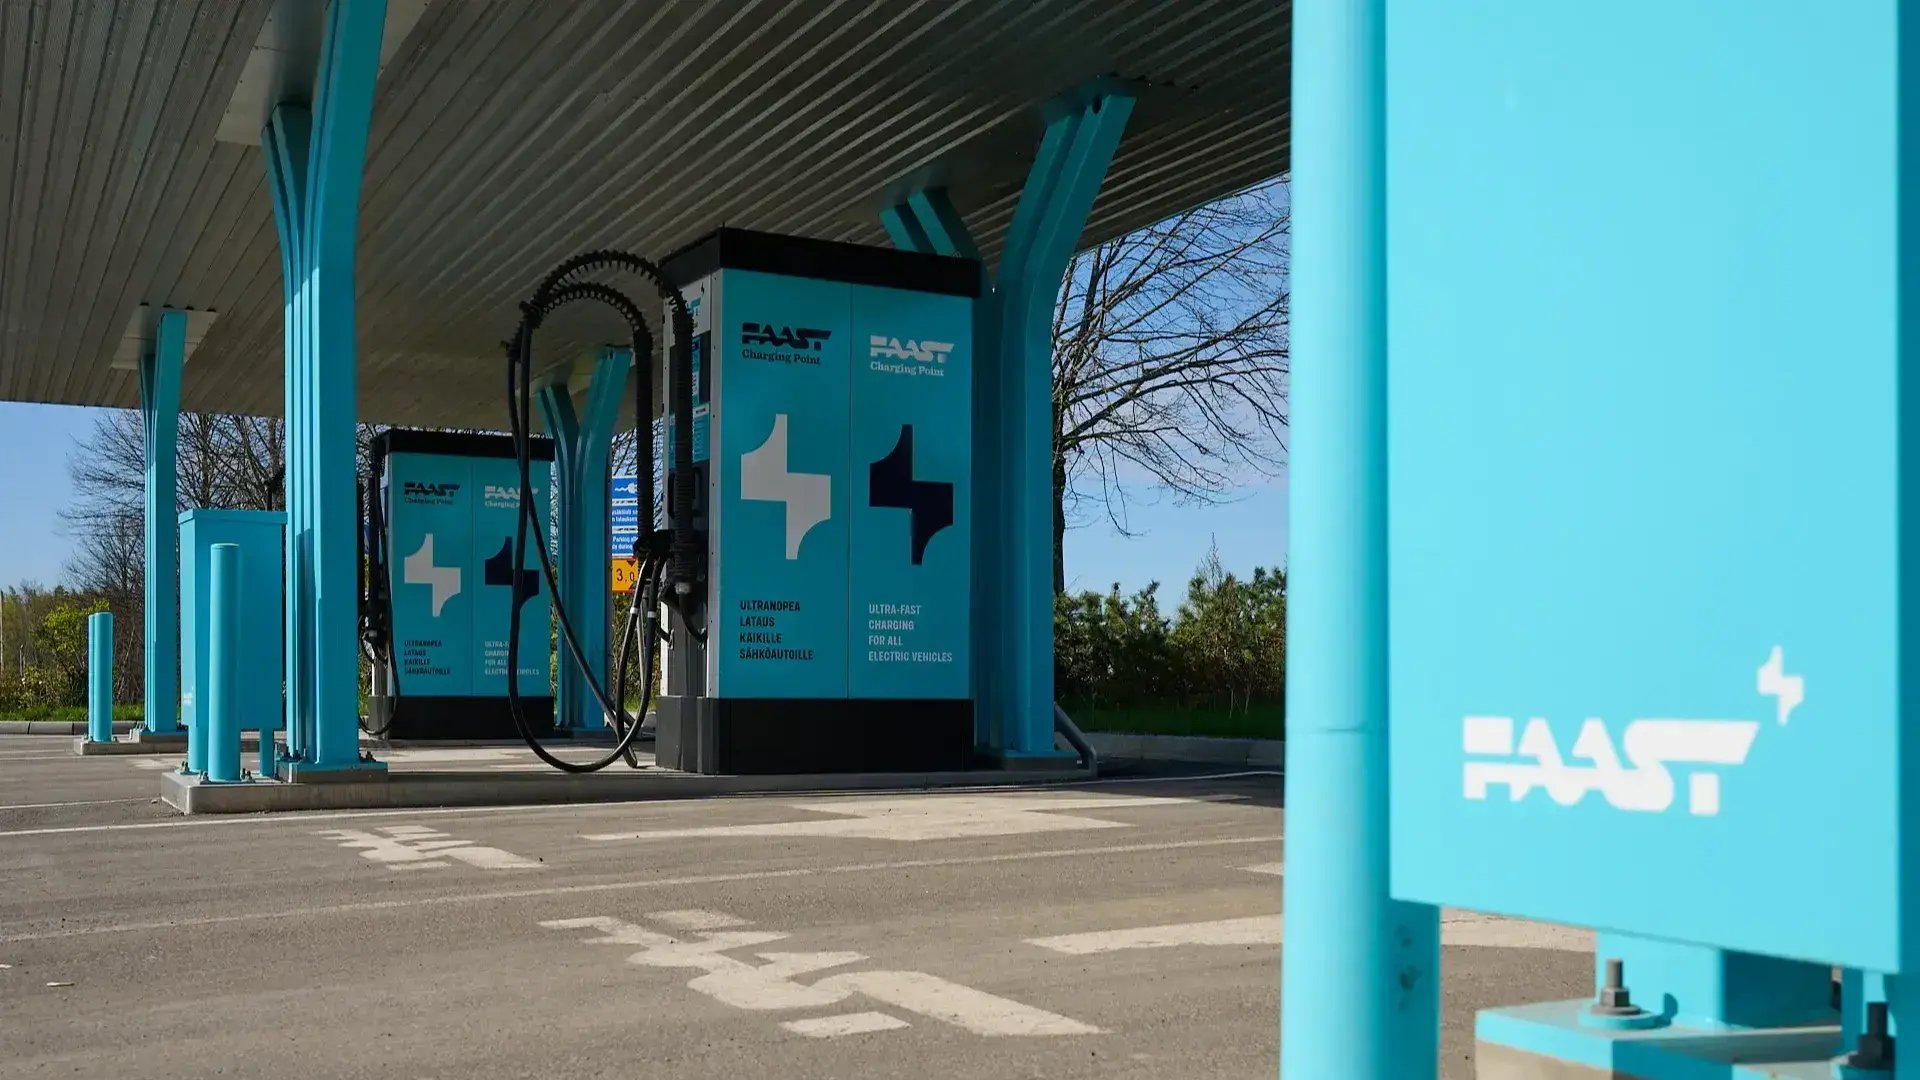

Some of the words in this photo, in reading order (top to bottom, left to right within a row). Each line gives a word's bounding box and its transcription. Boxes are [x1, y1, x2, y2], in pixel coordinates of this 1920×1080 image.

[742, 322, 832, 351] FAAST
[870, 335, 954, 363] FAAST
[742, 349, 791, 364] Charging
[793, 352, 821, 365] Point
[870, 361, 916, 375] Charging
[918, 365, 944, 377] Point
[404, 482, 461, 497] FAAST
[740, 600, 801, 612] ULTRANOPEA
[868, 604, 922, 615] ULTRA-FAST
[740, 616, 775, 627] LATAUS
[868, 619, 914, 630] CHARGING
[739, 632, 782, 644] KAIKILLE
[868, 635, 885, 646] FOR
[887, 635, 902, 646] ALL
[739, 647, 814, 661] SÄHKÖAUTOILLE
[868, 651, 909, 662] ELECTRIC
[911, 652, 953, 663] VEHICLES
[1463, 715, 1761, 816] FAAST
